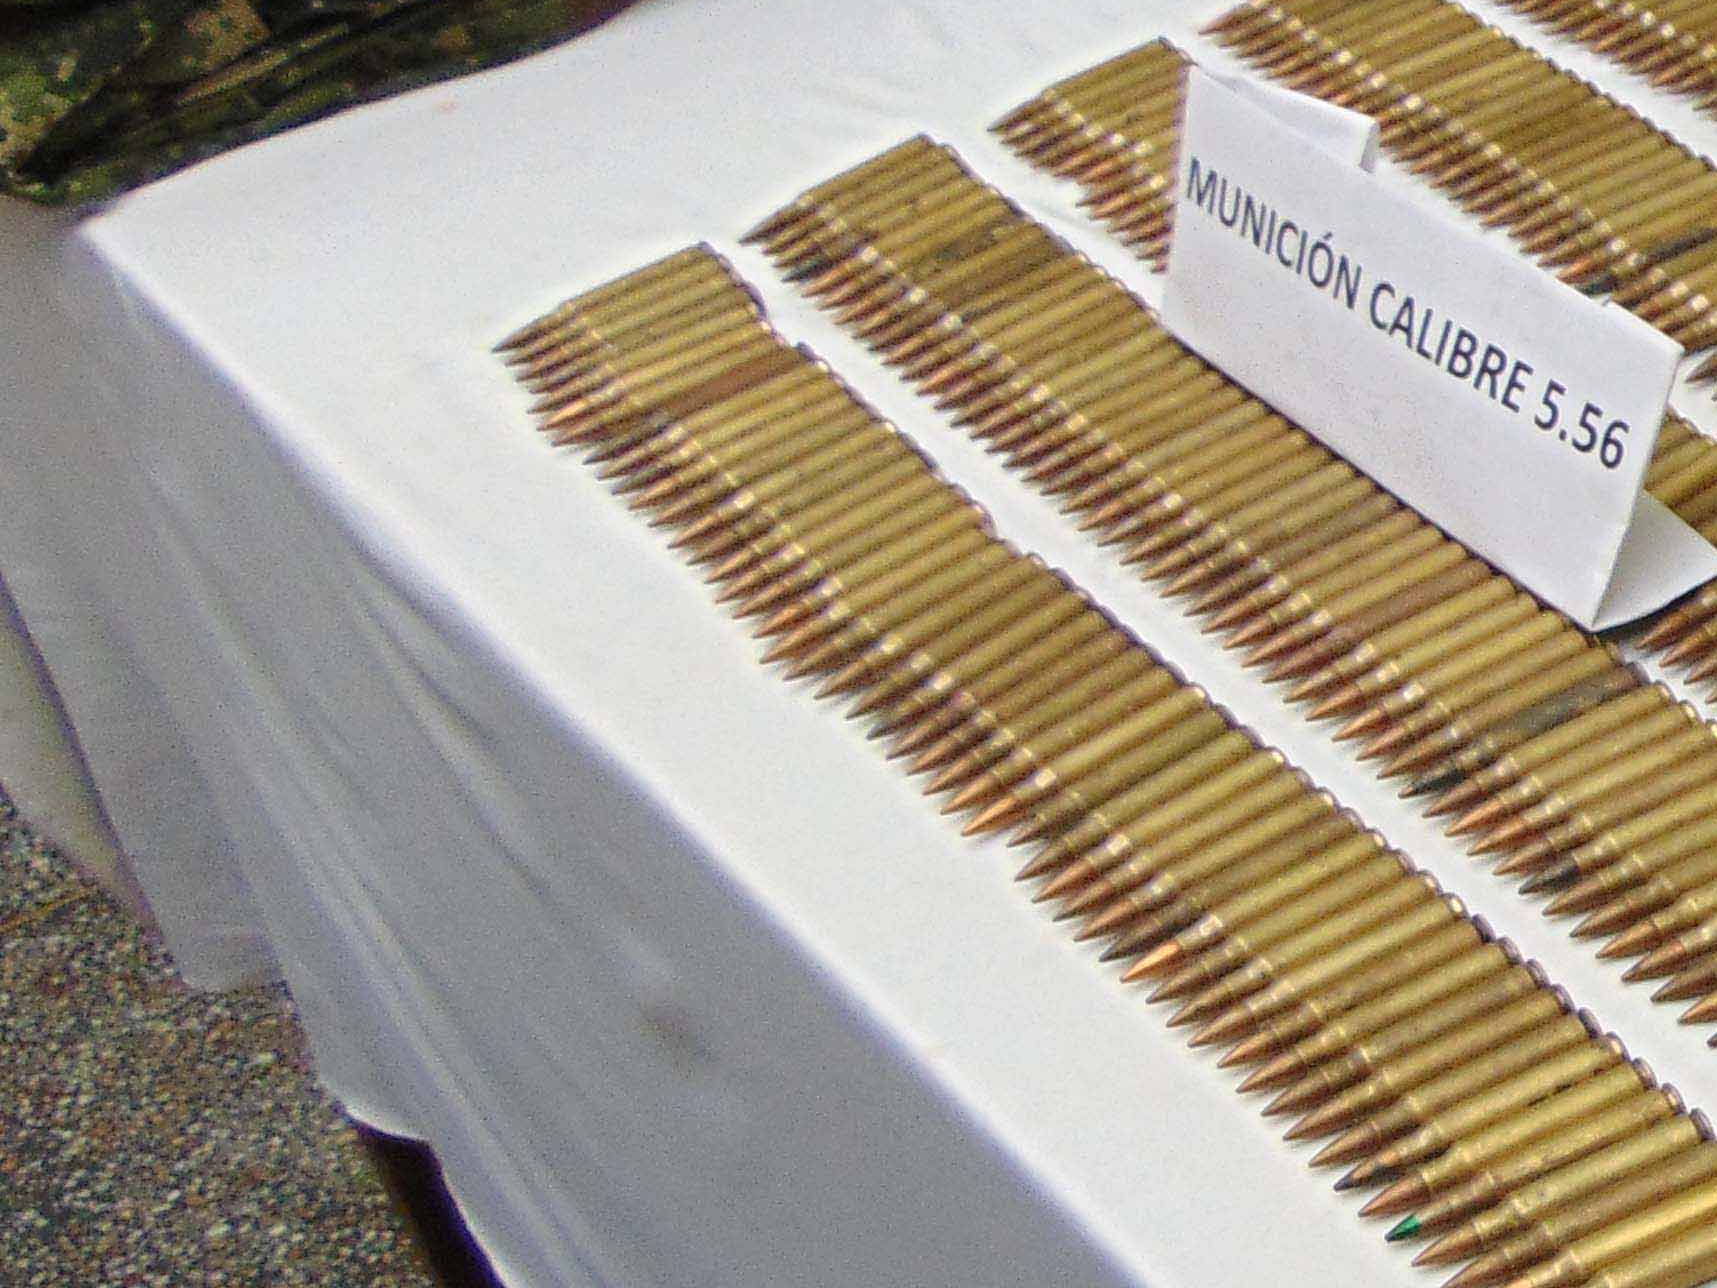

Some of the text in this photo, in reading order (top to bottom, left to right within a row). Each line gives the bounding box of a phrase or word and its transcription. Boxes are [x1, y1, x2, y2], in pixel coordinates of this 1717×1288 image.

[1186, 155, 1630, 470] MUNICIÓN CALIBRE 5.56
